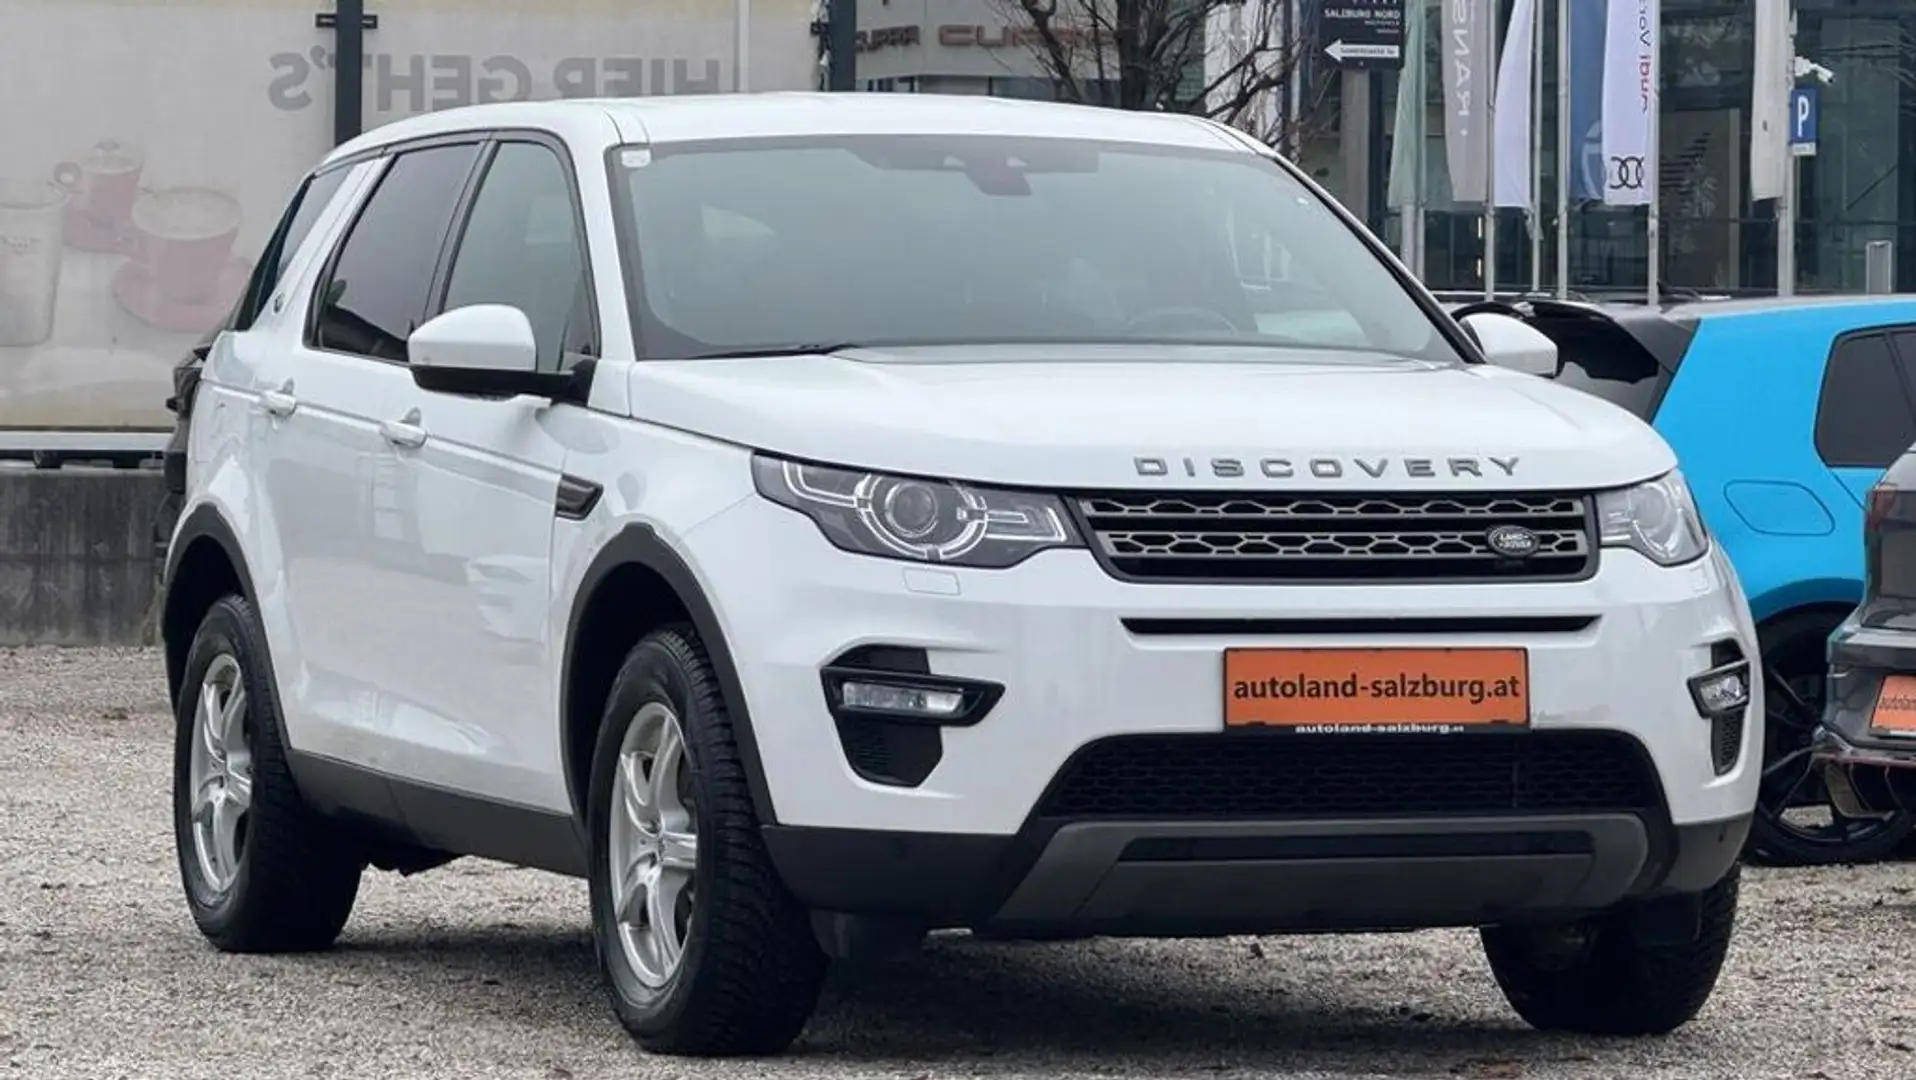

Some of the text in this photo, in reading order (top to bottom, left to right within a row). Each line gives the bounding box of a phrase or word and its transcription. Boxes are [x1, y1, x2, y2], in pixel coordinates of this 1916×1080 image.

[1798, 95, 1809, 137] P
[1134, 455, 1521, 478] DISCOVERY
[1234, 673, 1520, 705] autoland-salzburg.at
